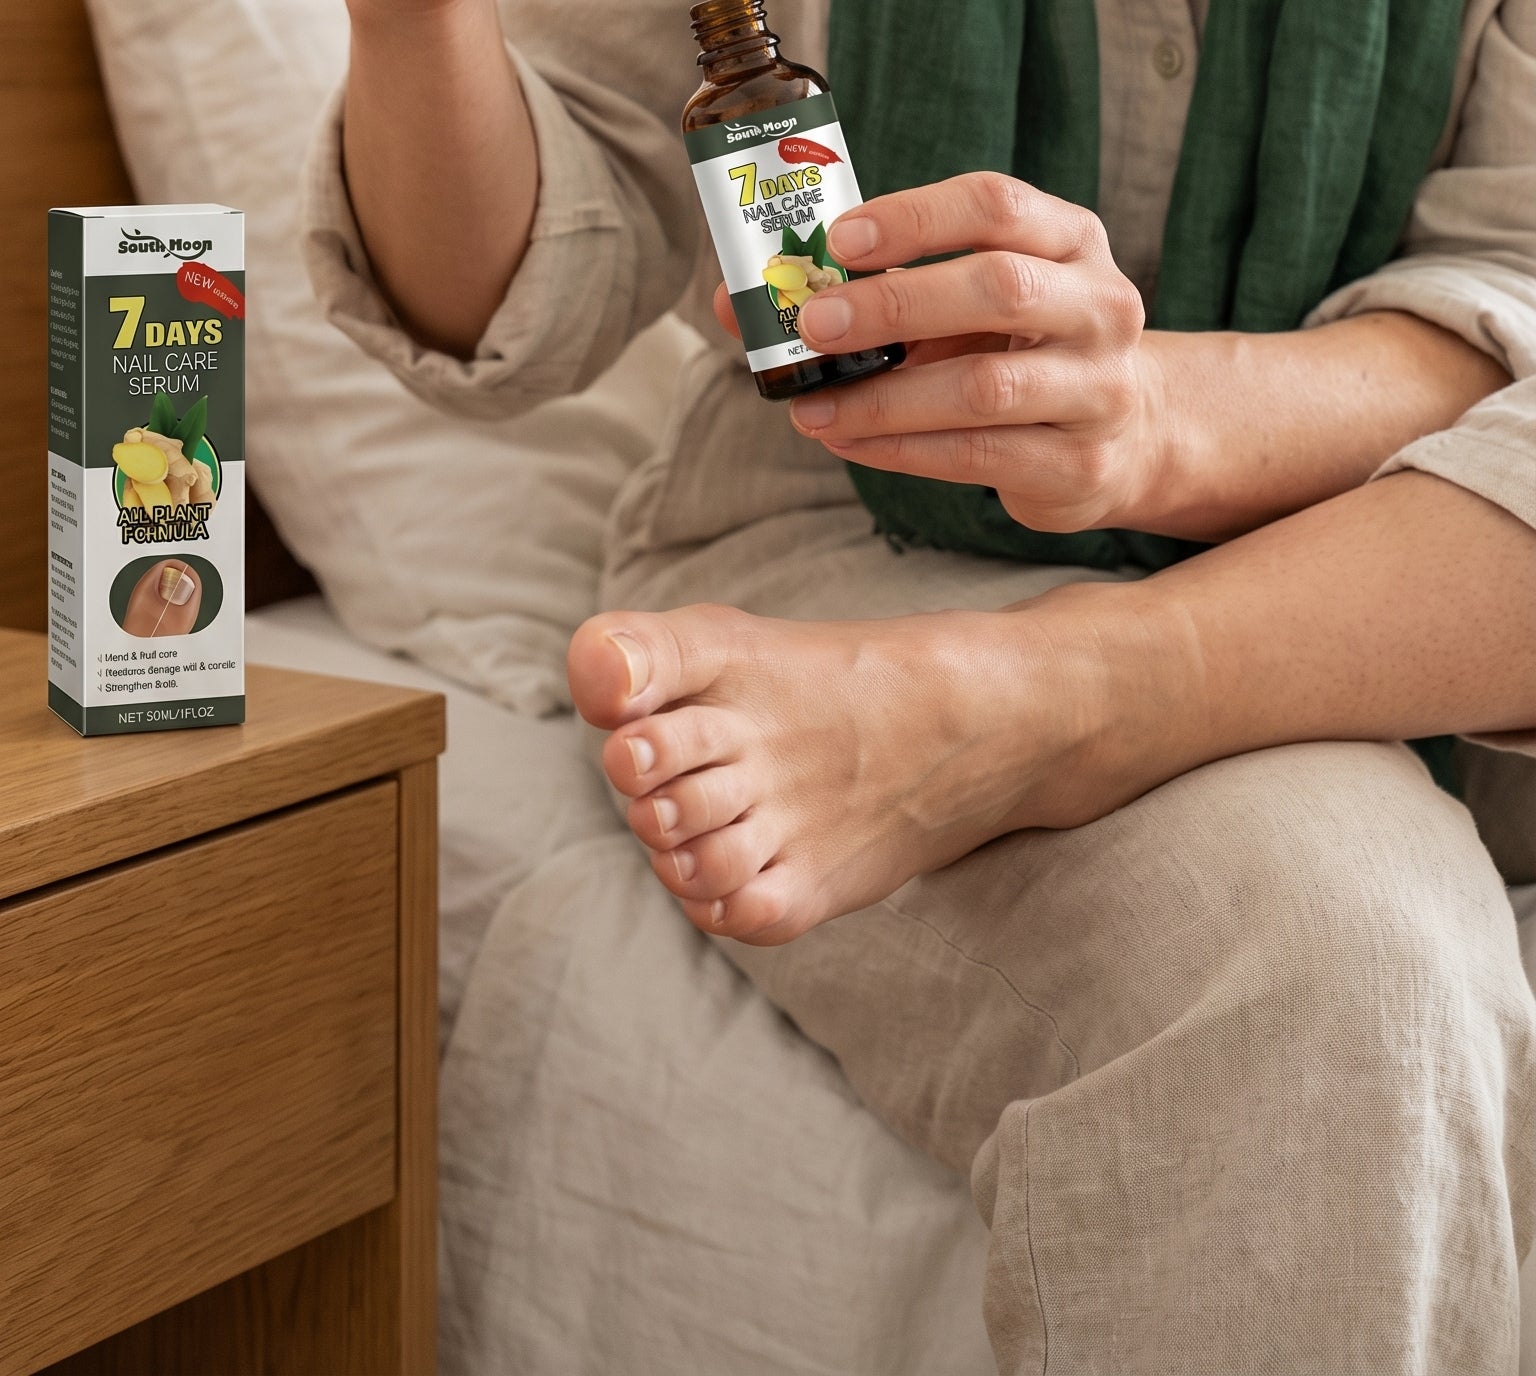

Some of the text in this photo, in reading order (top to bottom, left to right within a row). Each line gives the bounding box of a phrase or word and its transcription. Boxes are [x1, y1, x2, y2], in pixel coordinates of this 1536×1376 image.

[763, 117, 798, 134] Moon
[784, 144, 808, 153] NEW
[728, 162, 822, 207] 7 DAYS
[742, 187, 824, 224] NAIL CARE
[118, 238, 213, 254] South Moon
[184, 271, 215, 290] NEW
[108, 295, 146, 350] 7
[145, 318, 223, 348] DAYS
[787, 344, 804, 356] NET
[113, 351, 218, 374] NAIL CARE
[128, 374, 200, 395] SERUM
[117, 502, 212, 526] ALL PLANT
[131, 651, 137, 660] &
[200, 661, 206, 671] &
[118, 711, 144, 724] NET
